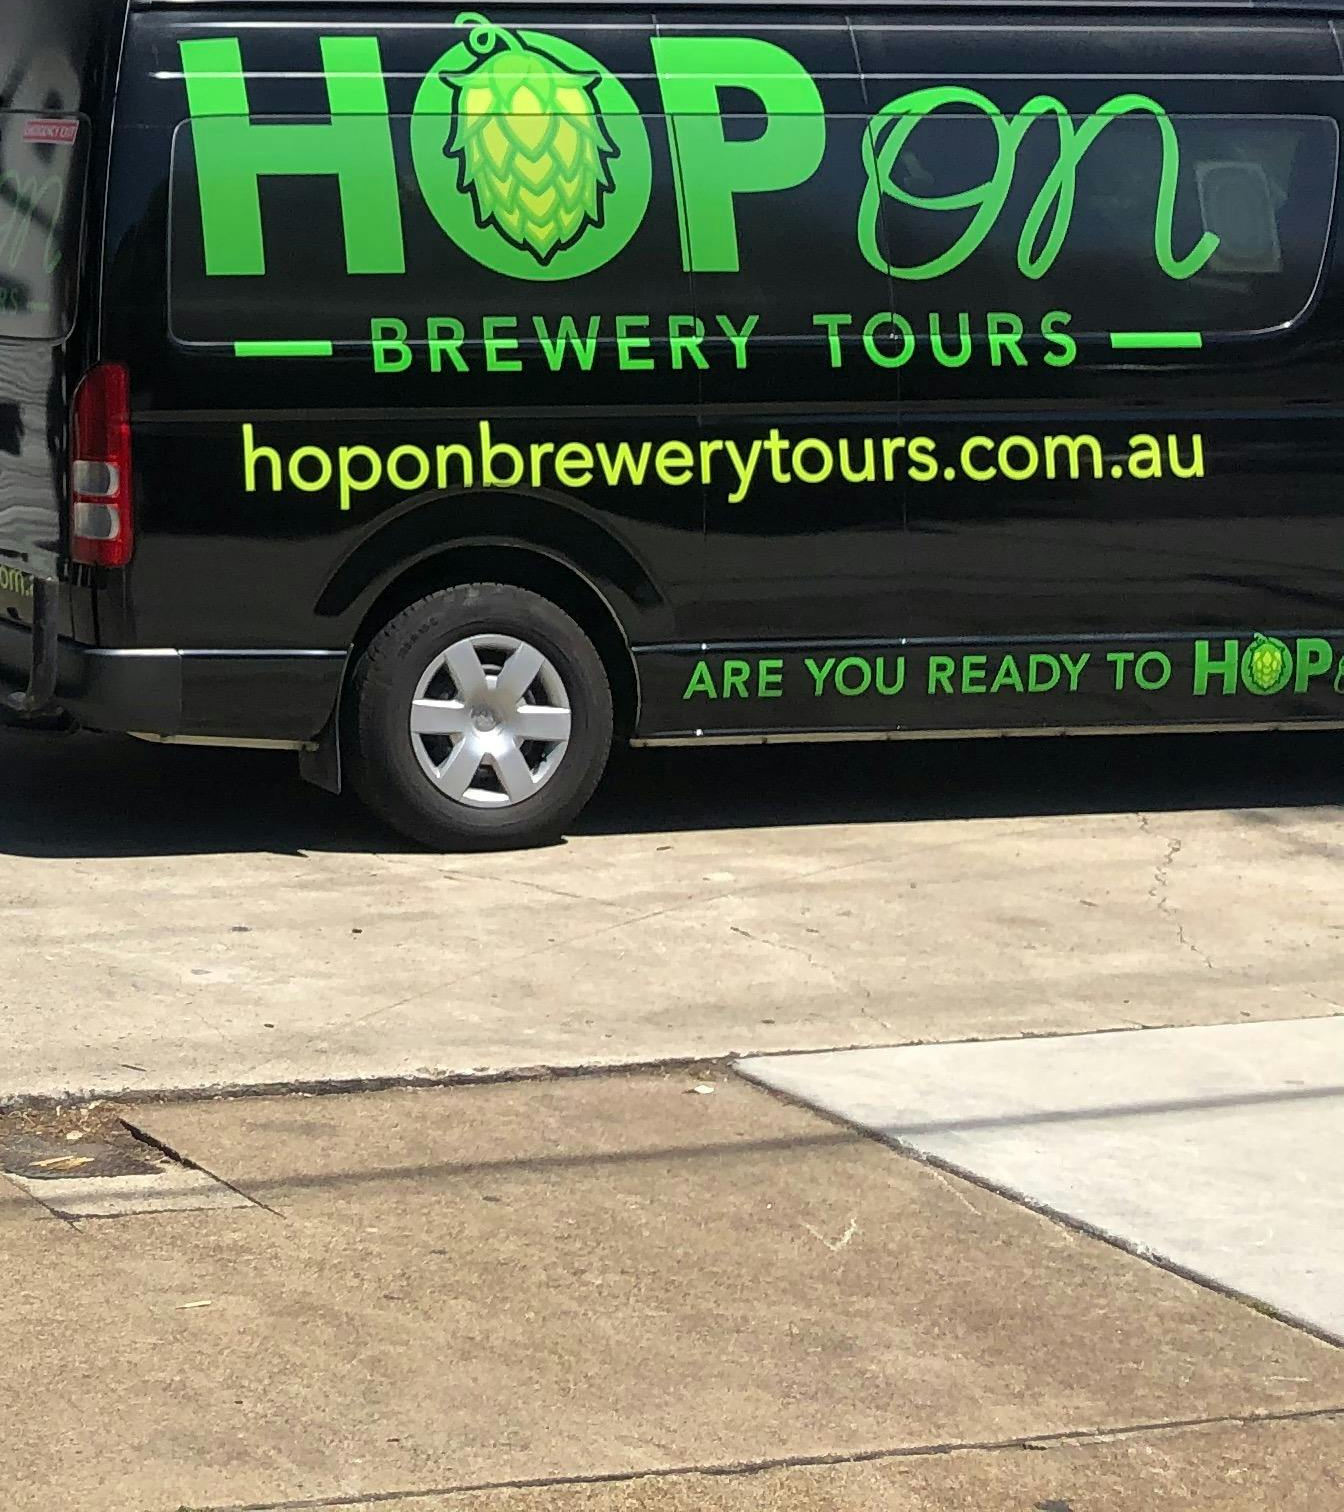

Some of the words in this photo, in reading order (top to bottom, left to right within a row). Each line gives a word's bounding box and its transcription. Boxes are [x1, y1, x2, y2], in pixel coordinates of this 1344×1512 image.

[179, 12, 827, 282] HOP
[370, 314, 760, 374] BREWERY
[812, 310, 1078, 369] TOURS
[241, 420, 1205, 509] hoponbrewerytours.com.au
[683, 657, 784, 700] ARE
[803, 656, 906, 697] YOU
[927, 653, 1092, 695] READY
[1106, 649, 1172, 692] TO
[1193, 632, 1333, 696] HOP
